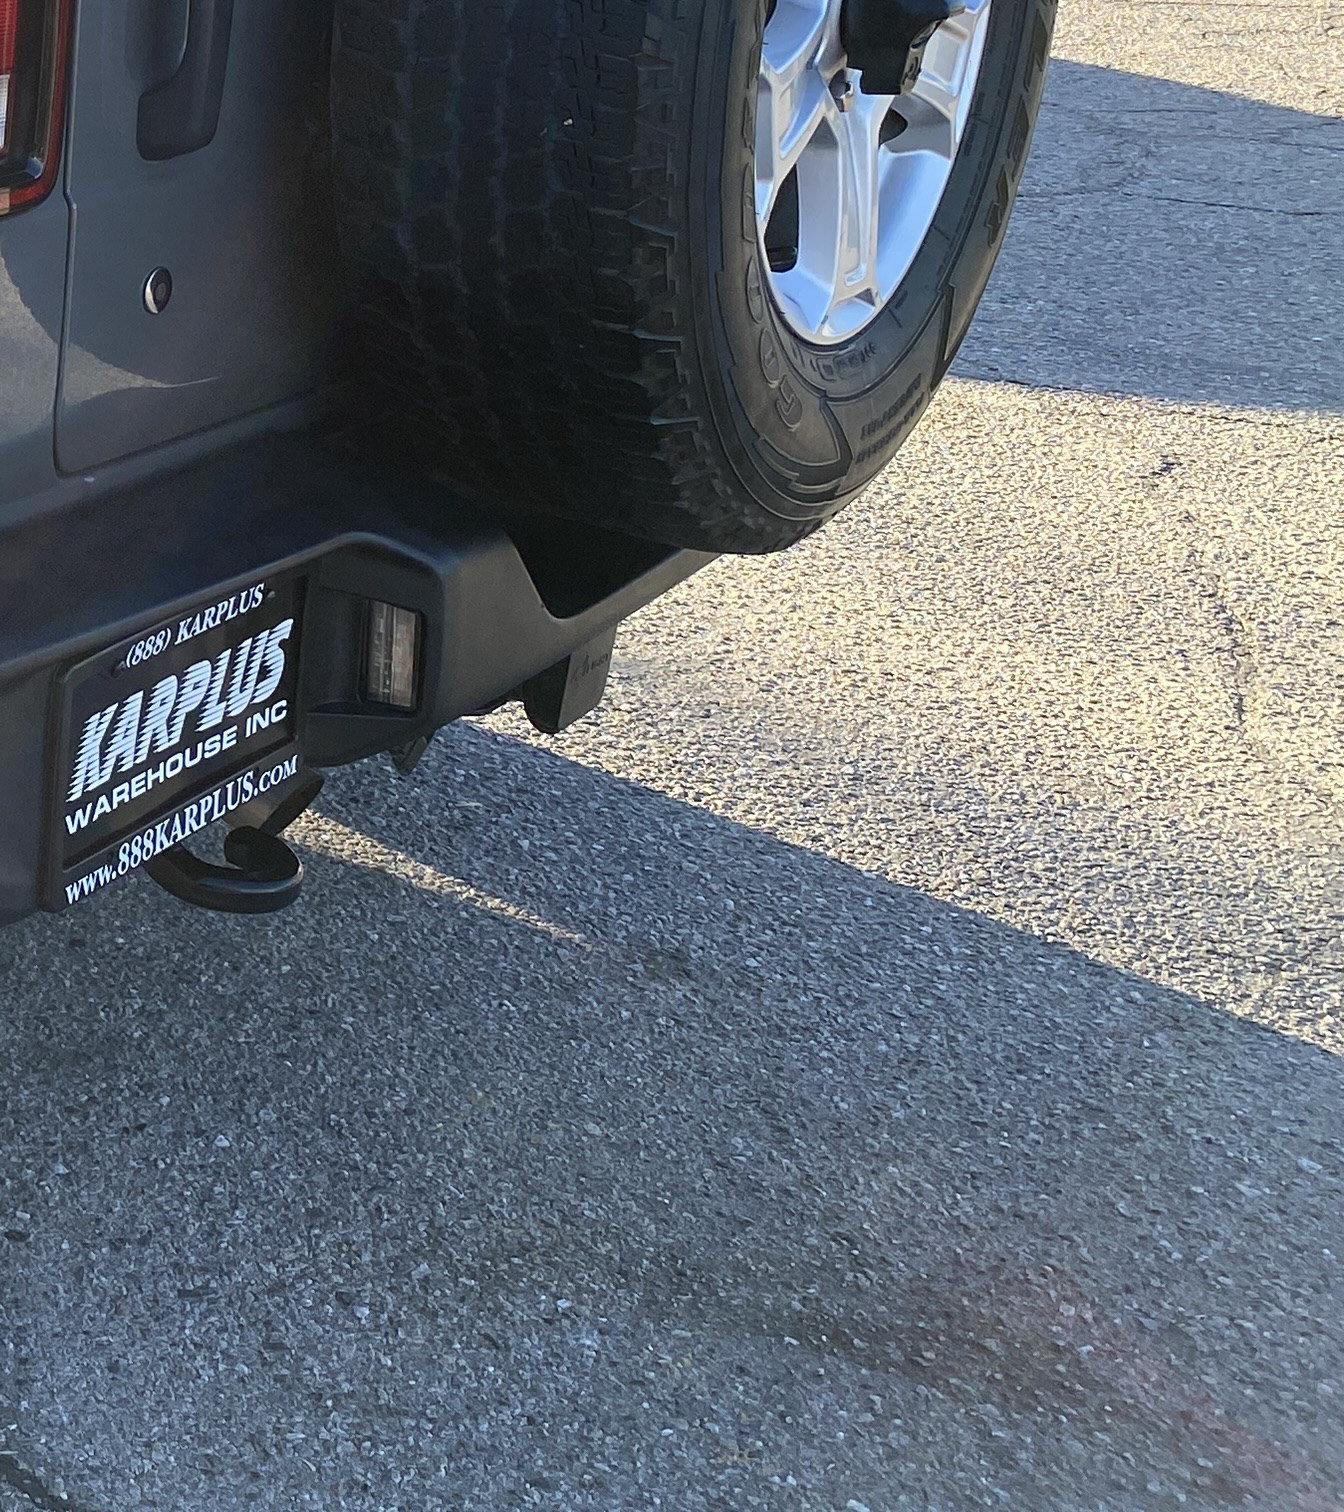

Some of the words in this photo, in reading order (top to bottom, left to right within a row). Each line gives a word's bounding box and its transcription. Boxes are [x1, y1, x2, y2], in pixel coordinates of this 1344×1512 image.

[125, 627, 172, 669] (888)
[174, 583, 265, 646] KARPLUS
[64, 725, 239, 835] WAREHOUSE
[244, 699, 289, 739] INC
[65, 618, 295, 803] KARPLUS
